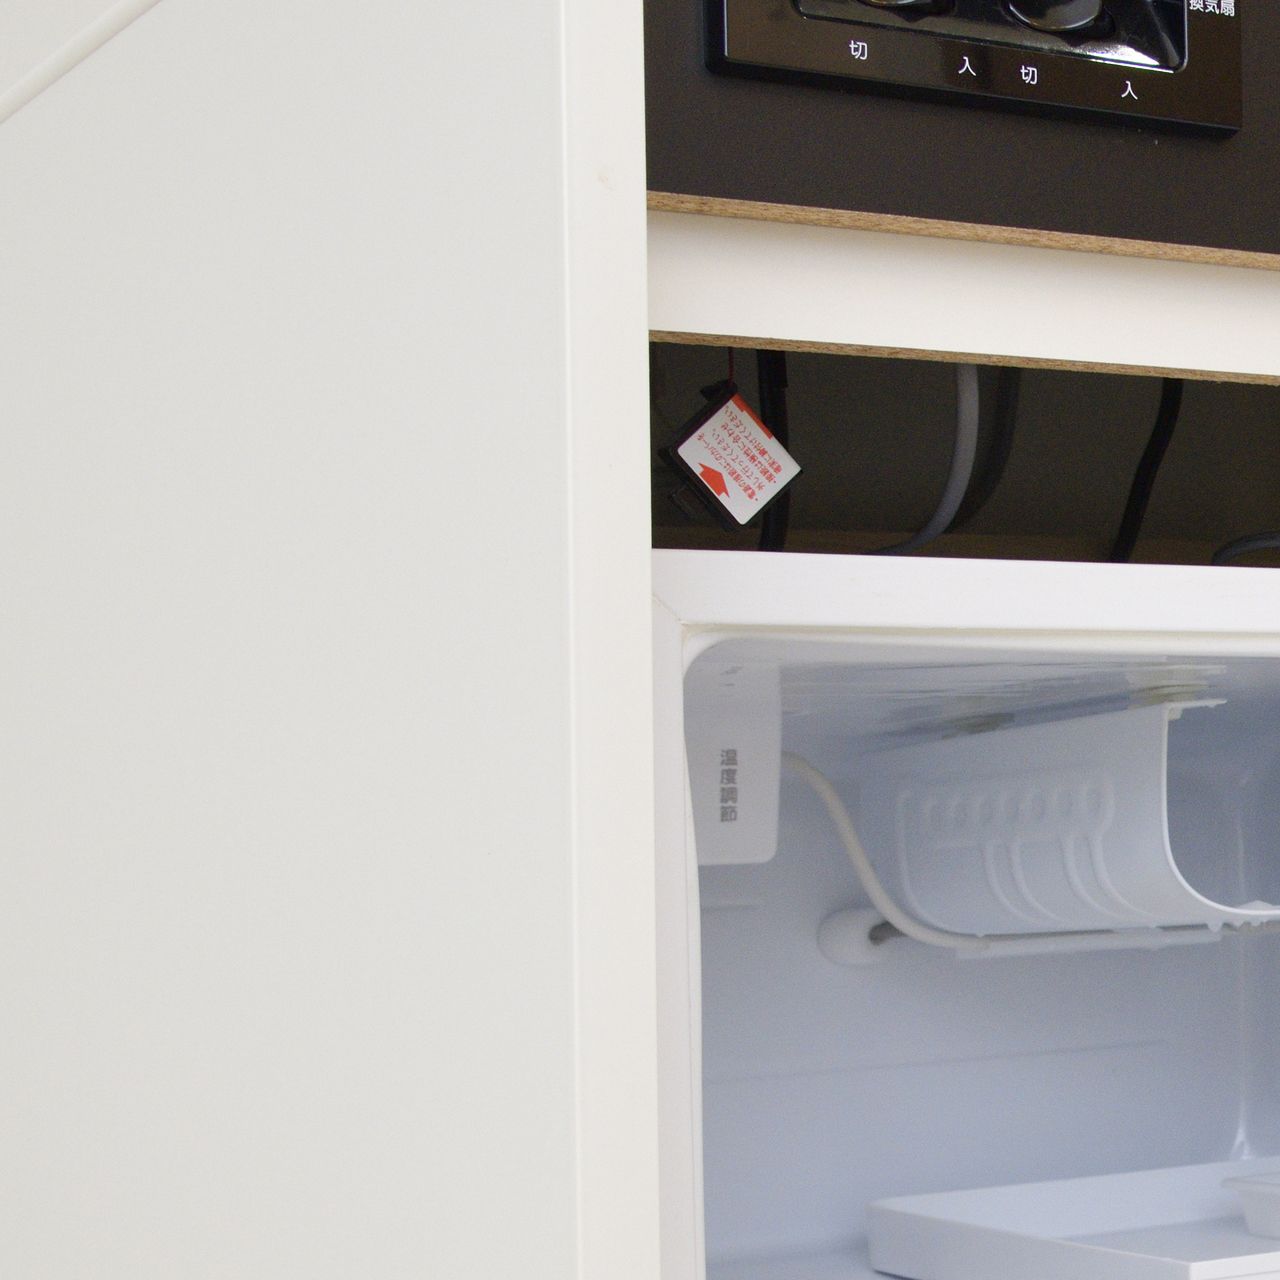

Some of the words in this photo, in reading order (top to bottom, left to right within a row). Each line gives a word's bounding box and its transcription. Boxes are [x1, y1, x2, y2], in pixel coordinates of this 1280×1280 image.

[848, 40, 868, 60] 切
[958, 56, 976, 76] 入
[1020, 66, 1038, 85] 切
[1121, 81, 1138, 100] 入
